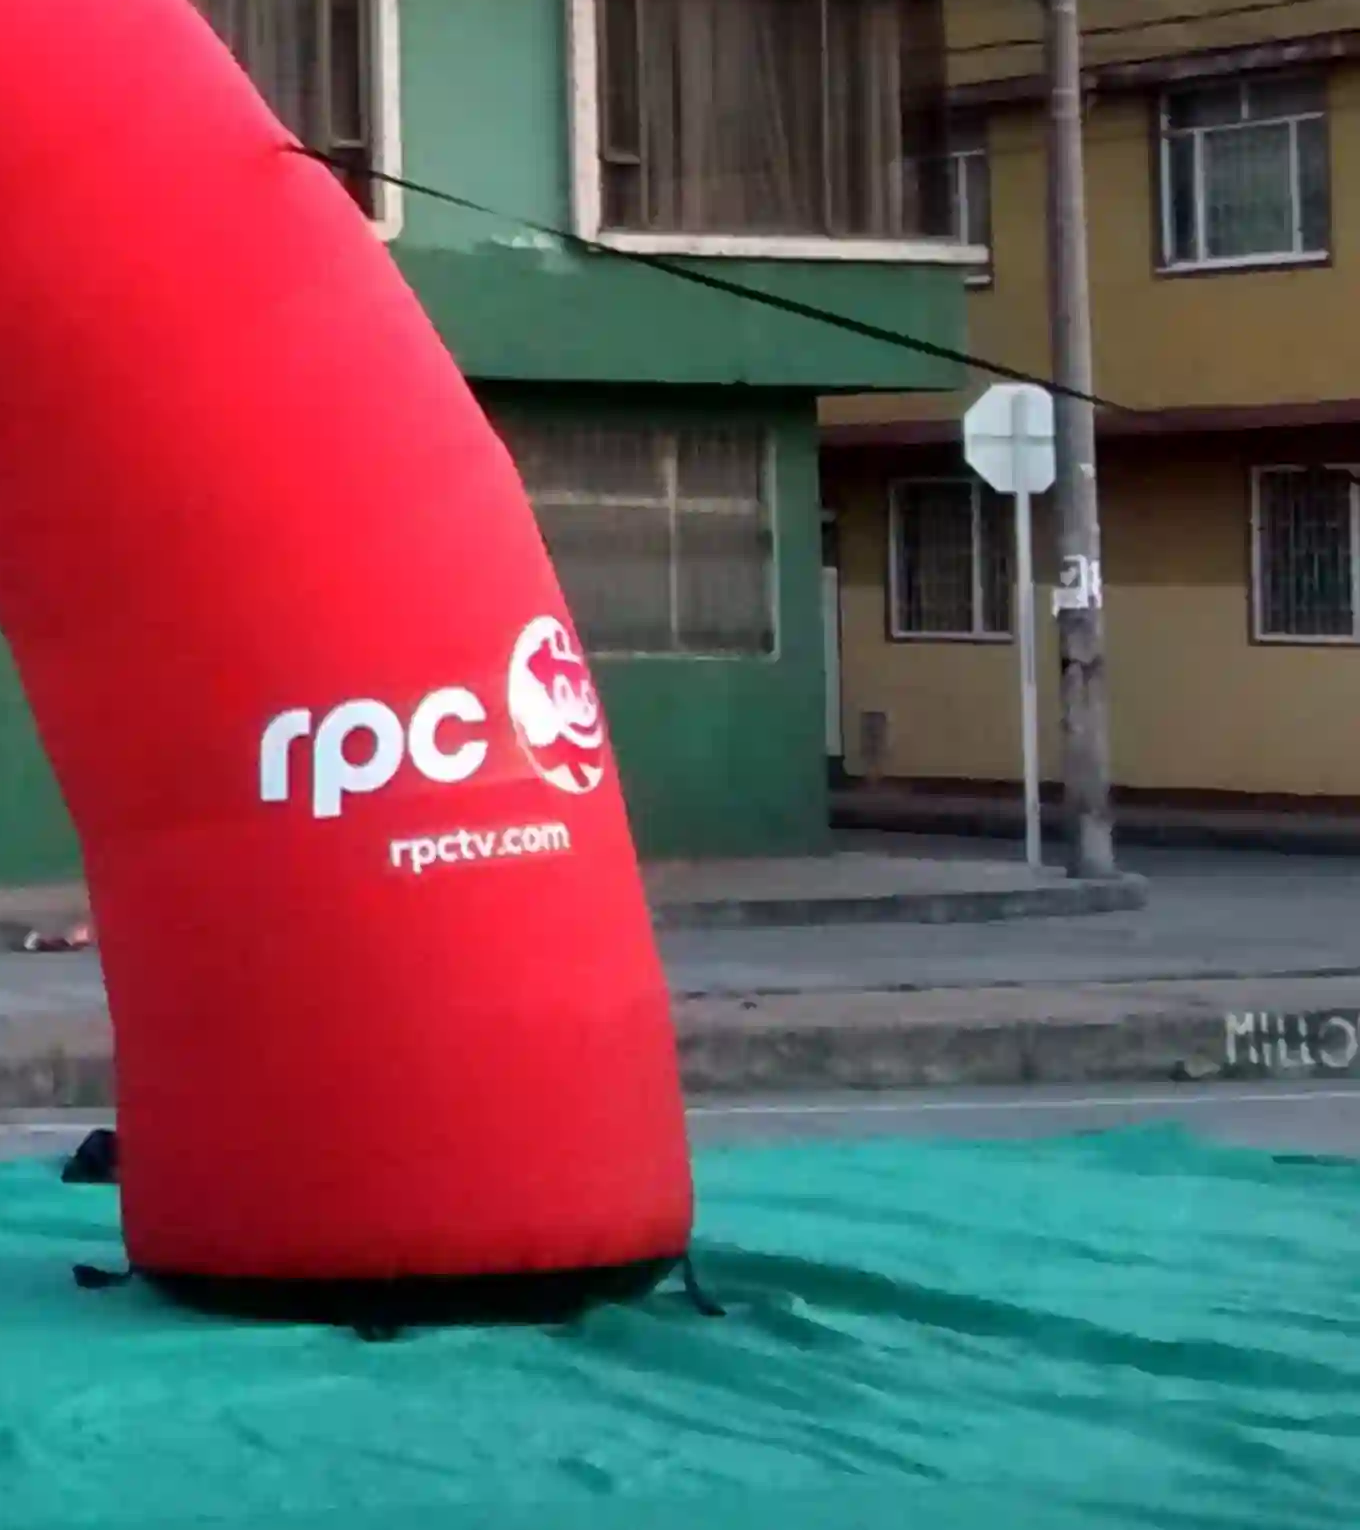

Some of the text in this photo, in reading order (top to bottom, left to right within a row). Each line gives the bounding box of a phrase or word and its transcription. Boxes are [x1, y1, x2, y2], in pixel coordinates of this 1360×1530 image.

[259, 685, 489, 819] rpc
[389, 820, 572, 874] rpctv.com
[1224, 1011, 1360, 1068] MILLO
